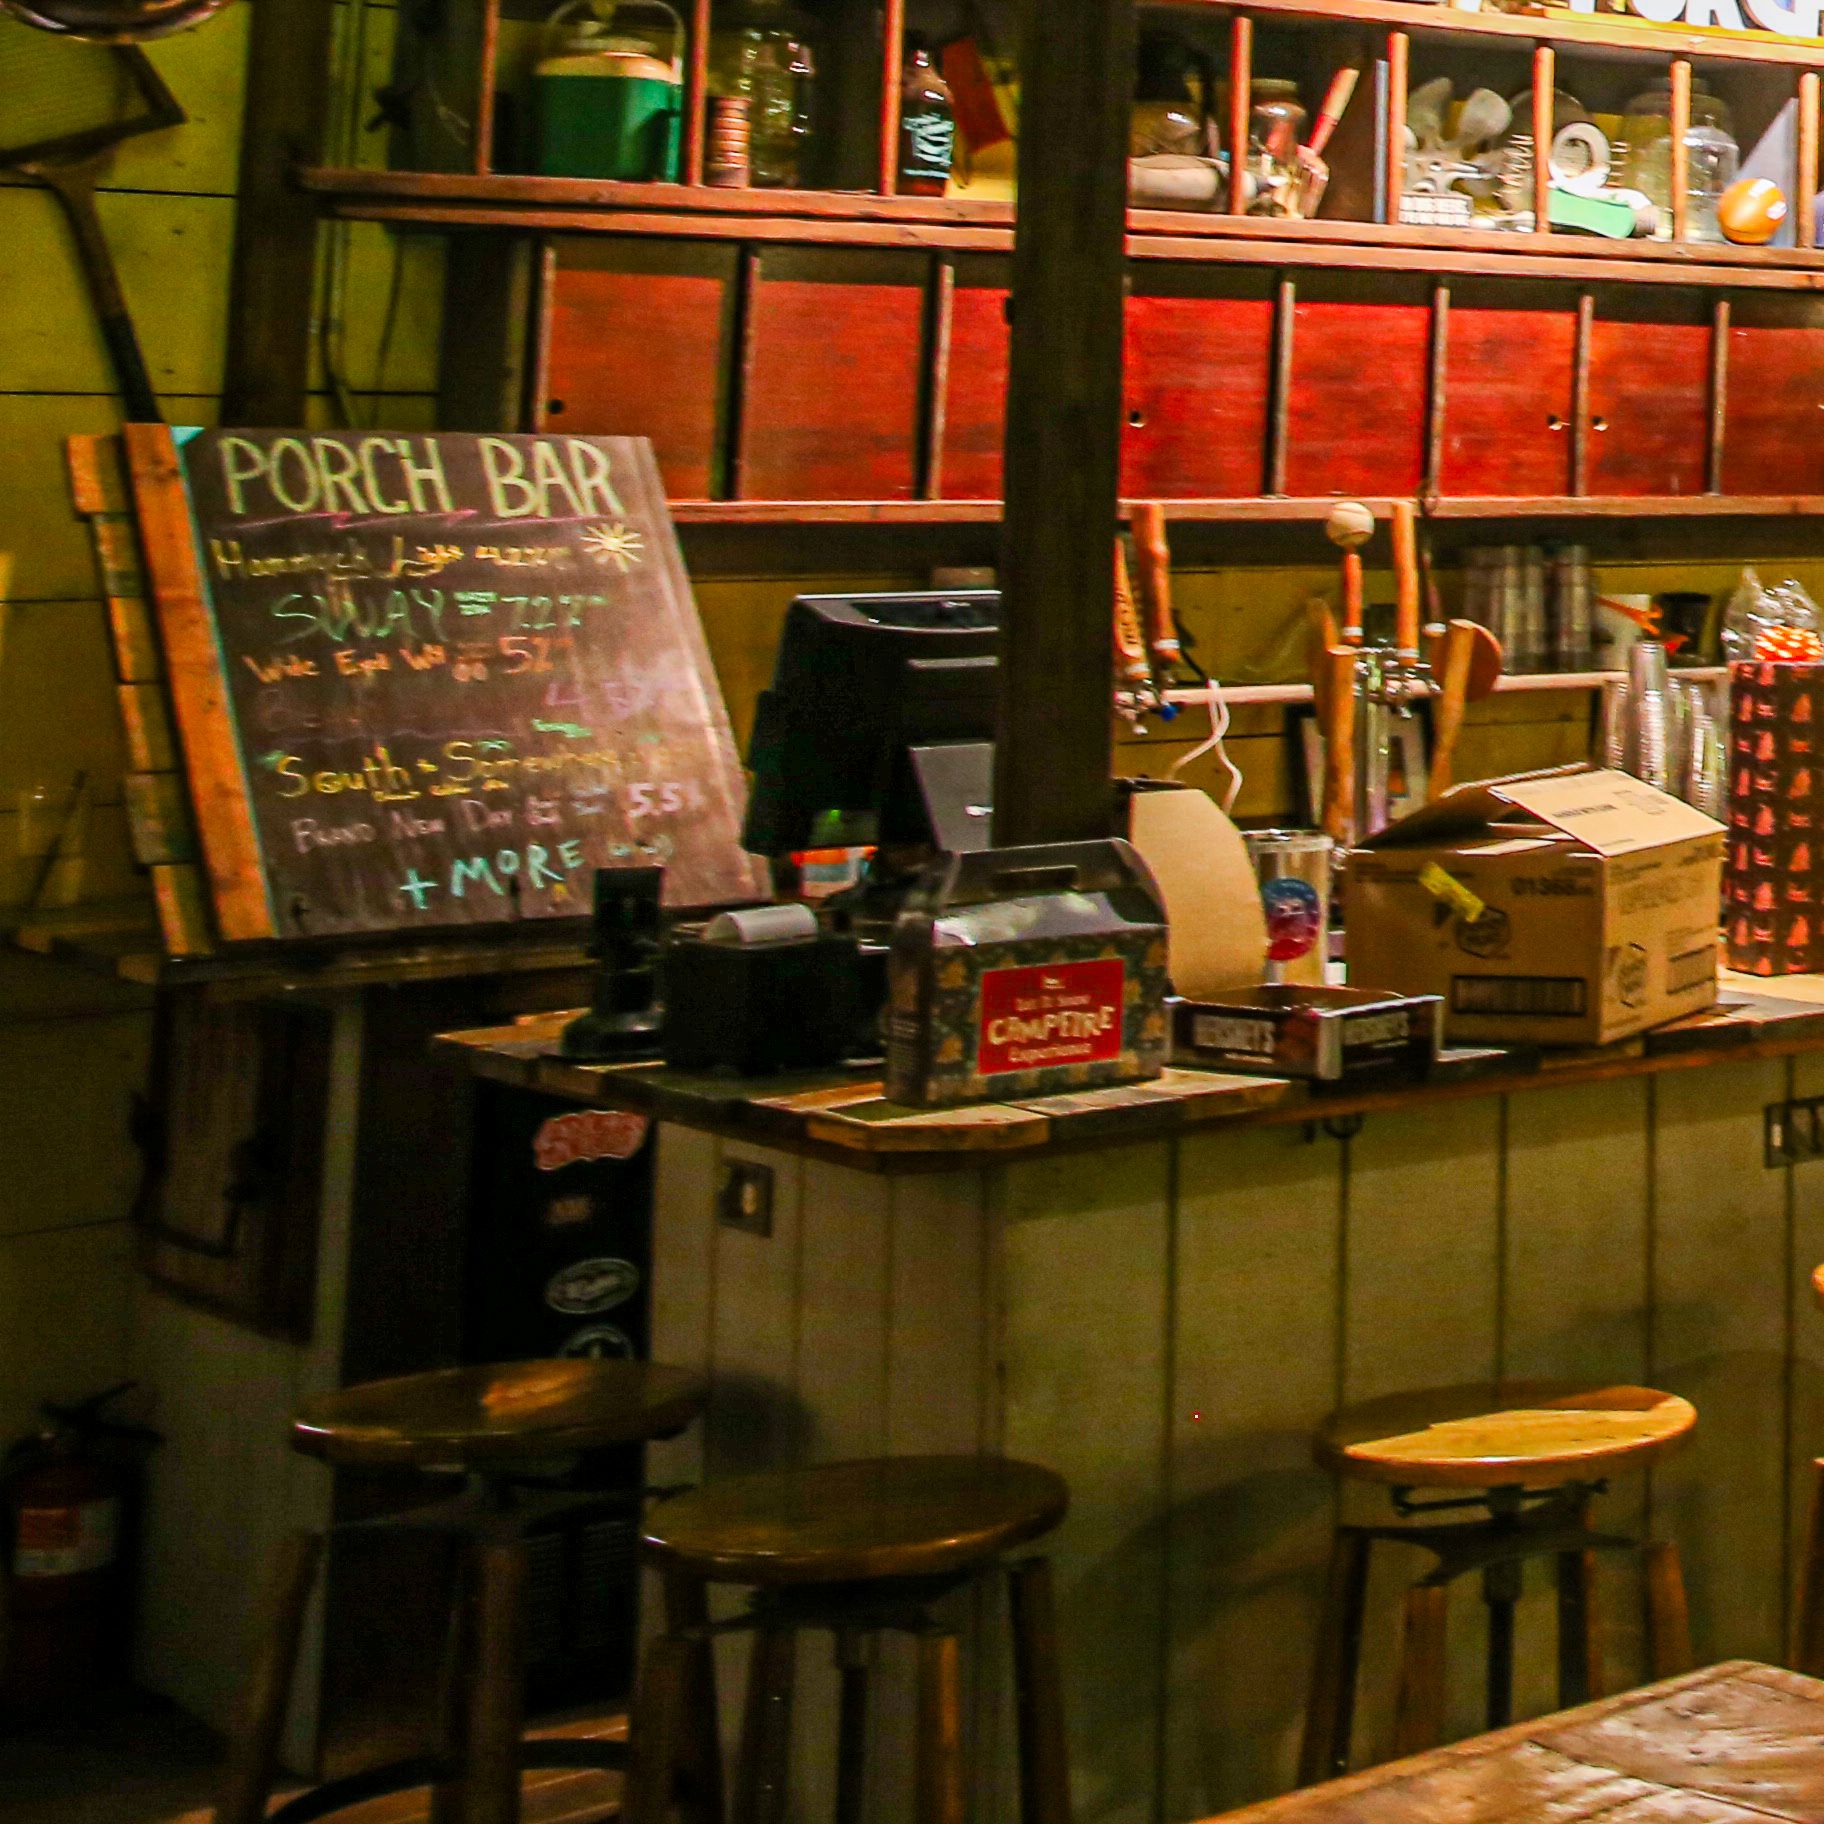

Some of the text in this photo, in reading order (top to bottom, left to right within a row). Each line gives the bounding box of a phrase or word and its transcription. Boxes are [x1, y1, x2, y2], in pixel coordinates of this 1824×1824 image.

[217, 436, 628, 518] PORCH BAR
[269, 588, 450, 643] SWAY
[450, 838, 586, 897] MORE
